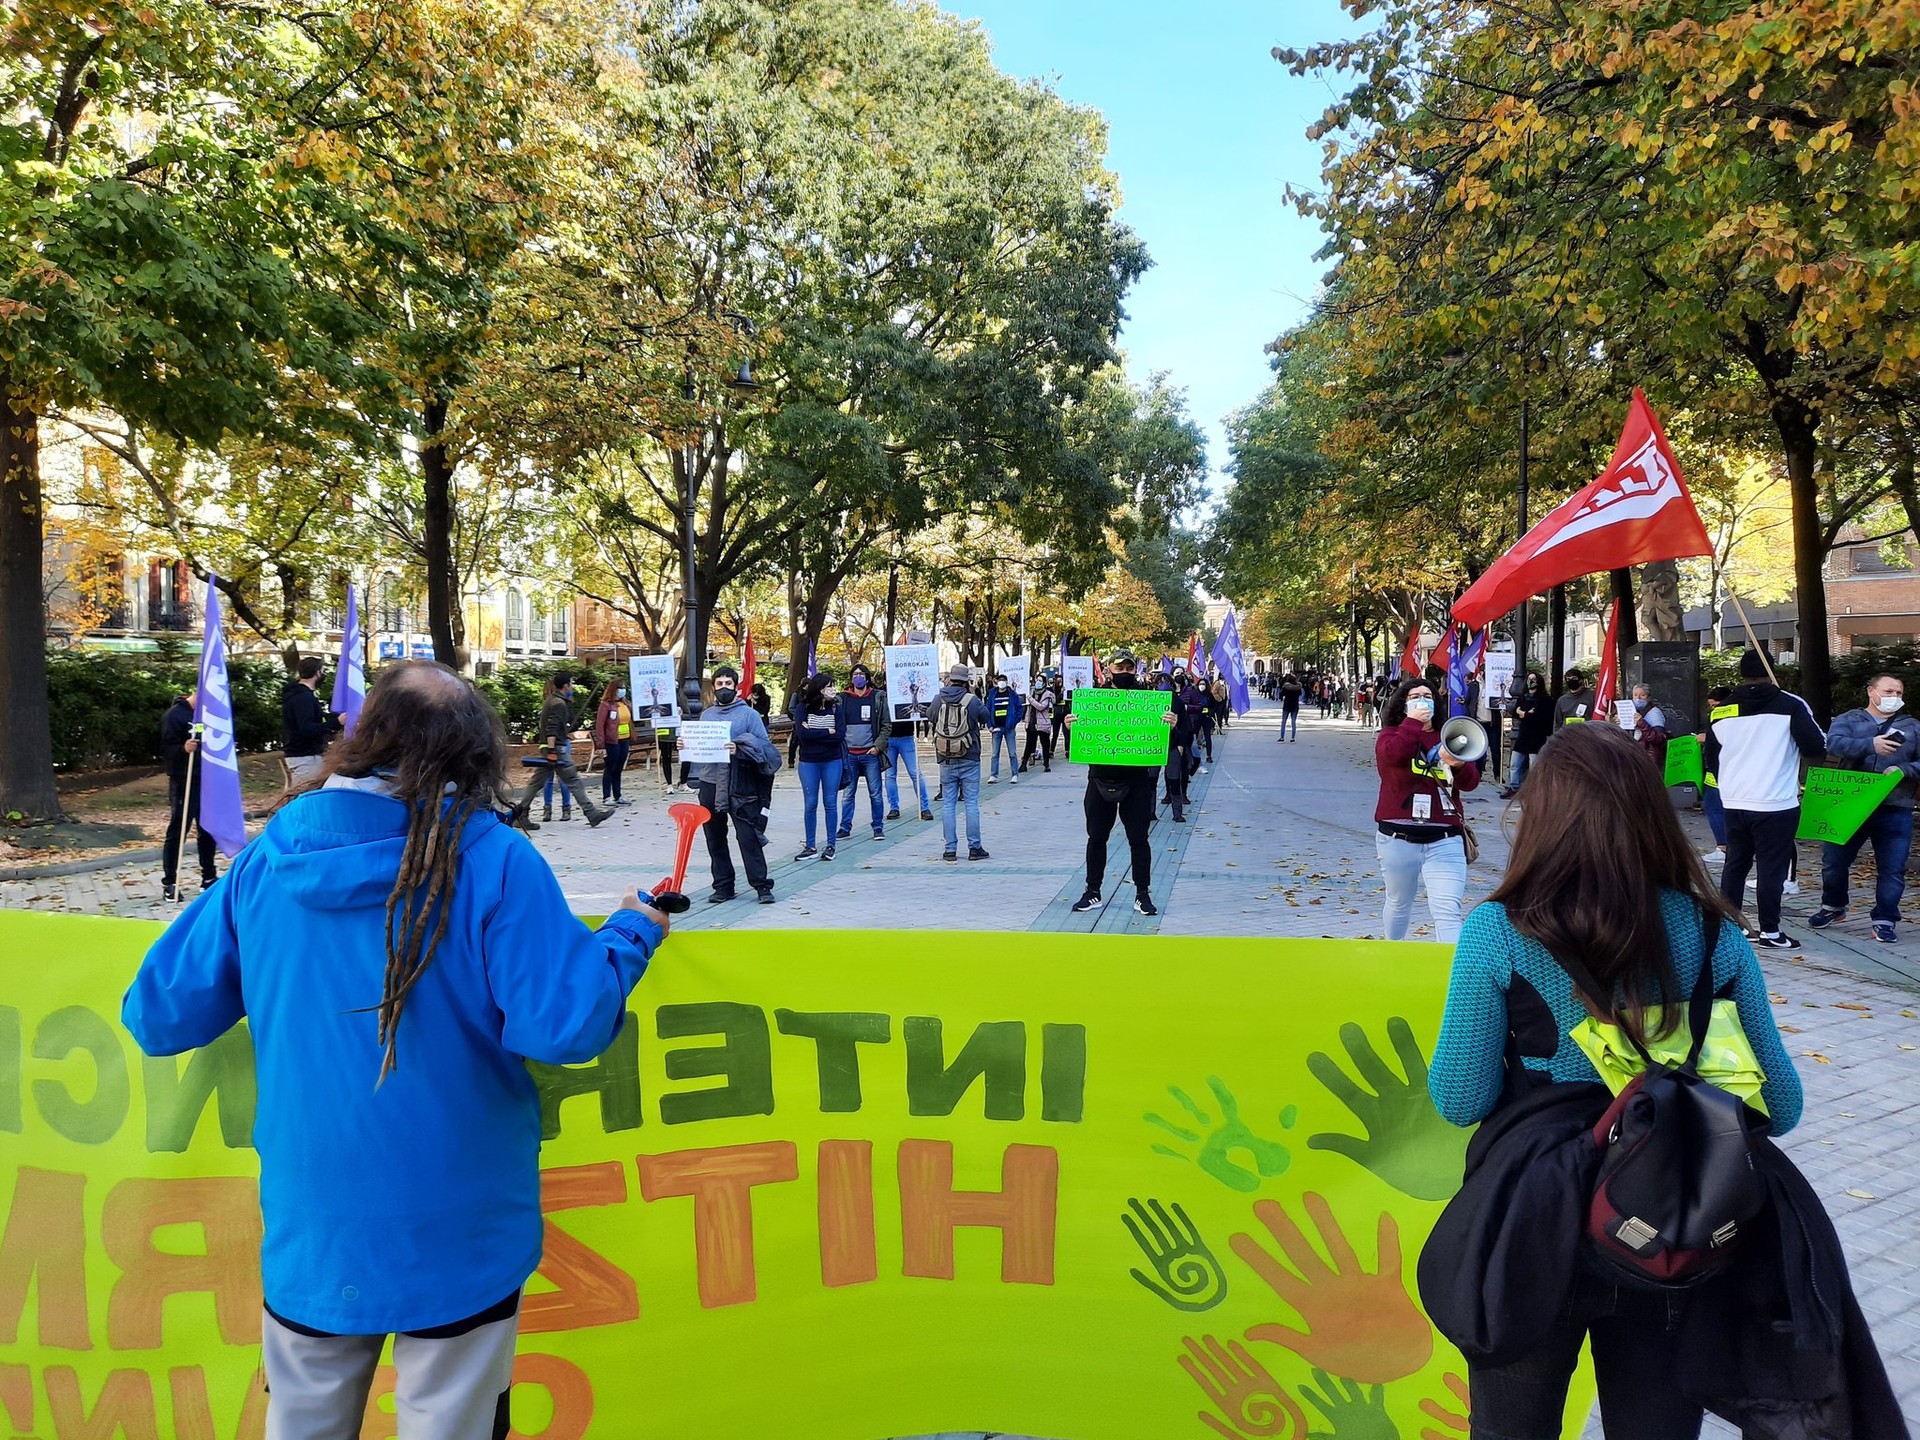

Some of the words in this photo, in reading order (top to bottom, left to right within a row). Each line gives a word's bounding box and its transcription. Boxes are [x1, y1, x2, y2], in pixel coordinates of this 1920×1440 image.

[894, 654, 929, 662] SOZIALA
[1113, 717, 1125, 726] de
[1096, 732, 1111, 742] es
[1080, 747, 1093, 755] es
[1810, 769, 1826, 781] En
